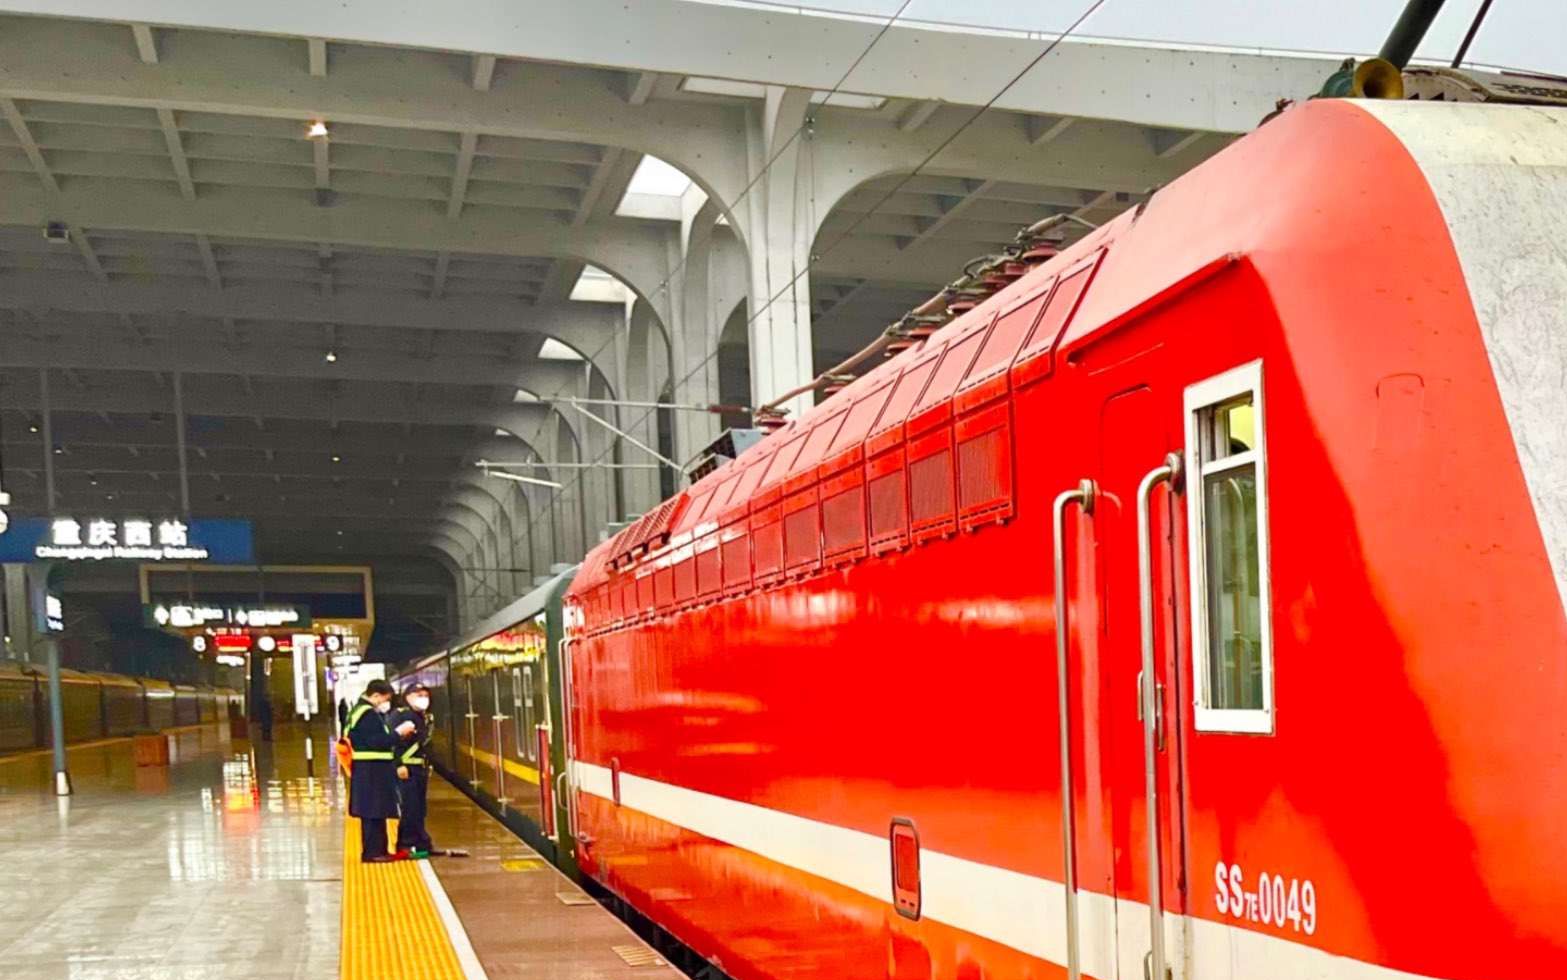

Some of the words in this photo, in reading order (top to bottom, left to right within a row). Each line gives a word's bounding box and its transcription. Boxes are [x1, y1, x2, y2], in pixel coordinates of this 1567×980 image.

[53, 517, 188, 546] 重庆西站
[193, 635, 206, 652] 8
[326, 635, 340, 651] 9
